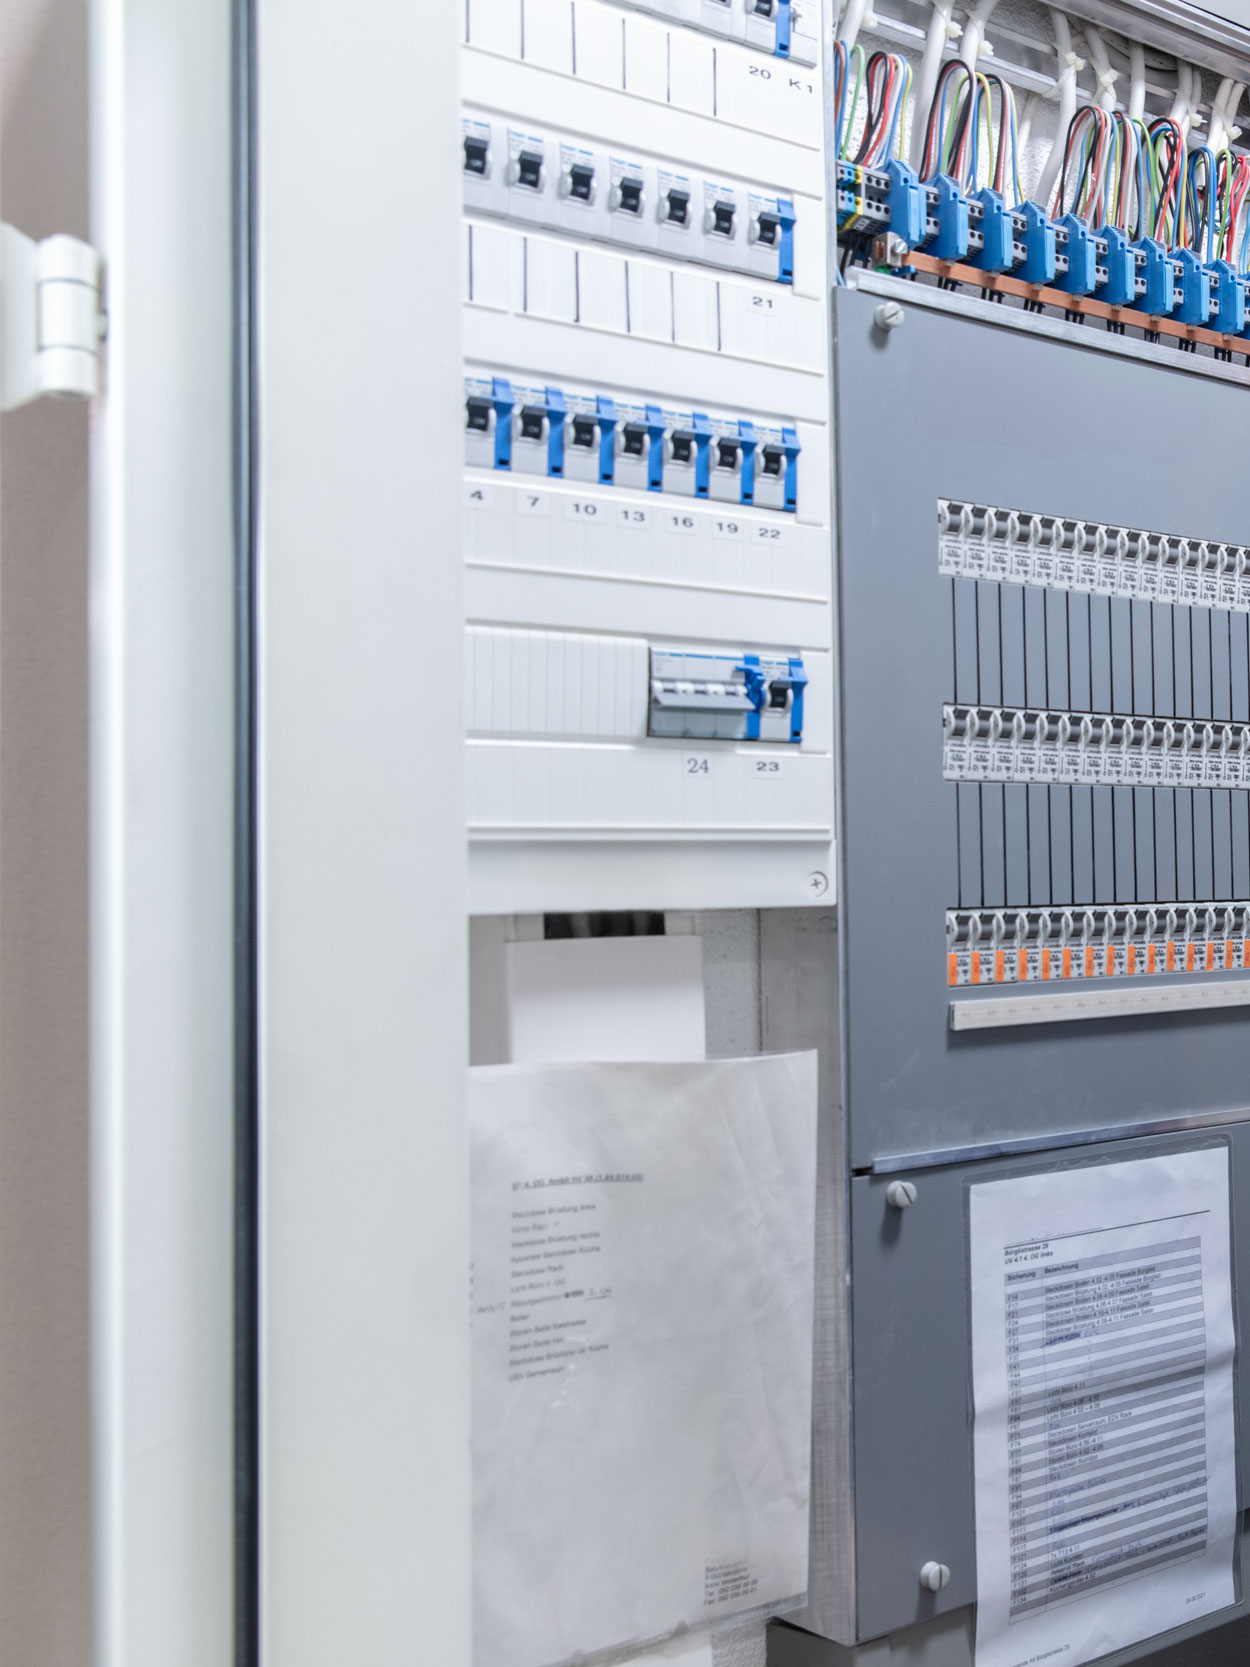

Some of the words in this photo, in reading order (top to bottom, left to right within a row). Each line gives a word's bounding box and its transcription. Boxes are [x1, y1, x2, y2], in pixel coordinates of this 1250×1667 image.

[748, 66, 772, 80] 20
[752, 296, 774, 309] 21
[470, 490, 485, 501] 4
[528, 497, 540, 507] 7
[572, 504, 598, 516] 10
[622, 510, 646, 522] 13
[672, 516, 695, 528] 16
[717, 522, 740, 534] 19
[759, 528, 782, 540] 22
[687, 758, 710, 774] 24
[756, 761, 781, 772] 23
[1030, 1252, 1039, 1260] OG
[1007, 1271, 1036, 1282] Sicherung
[1044, 1263, 1079, 1275] Bezeichnung
[1115, 1269, 1136, 1279] Fassade
[1122, 1275, 1142, 1285] Fassade
